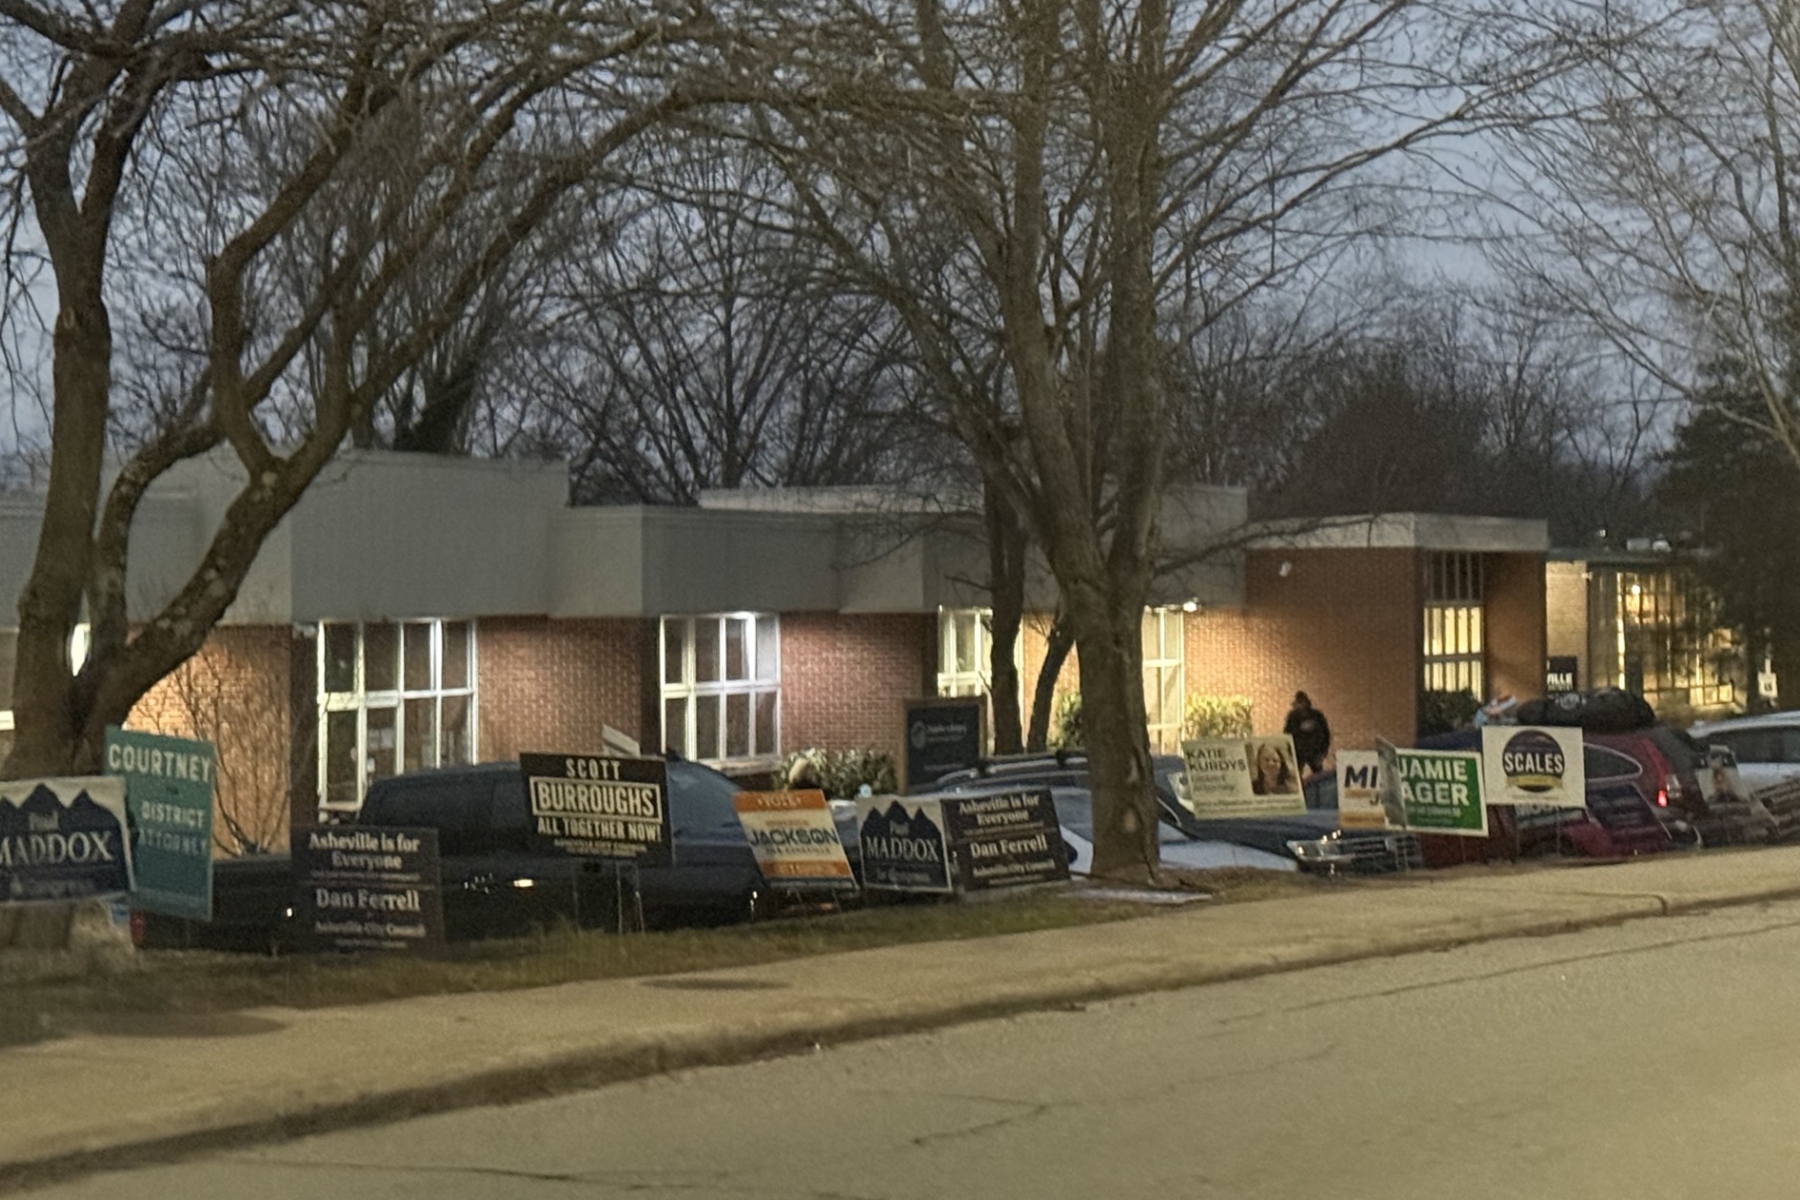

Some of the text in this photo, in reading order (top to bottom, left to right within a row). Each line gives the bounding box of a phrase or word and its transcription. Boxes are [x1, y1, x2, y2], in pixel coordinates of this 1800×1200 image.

[108, 743, 211, 783] COURTNEY
[565, 757, 620, 781] SCOTT
[1398, 757, 1468, 782] JAMIE
[1504, 752, 1564, 774] SCALES
[537, 781, 655, 817] BURROUGHS
[1021, 793, 1040, 807] for
[141, 800, 206, 829] DISTRICT
[976, 809, 1029, 826] Everyone
[537, 817, 662, 843] ALL TOGETHER NOW!
[751, 827, 842, 848] JACKSON
[309, 832, 421, 853] Asheville is for
[865, 836, 940, 863] MADDOX
[969, 833, 1048, 858] Dan Ferrell
[331, 850, 403, 871] Everyone
[316, 888, 421, 912] Dan Ferrell
